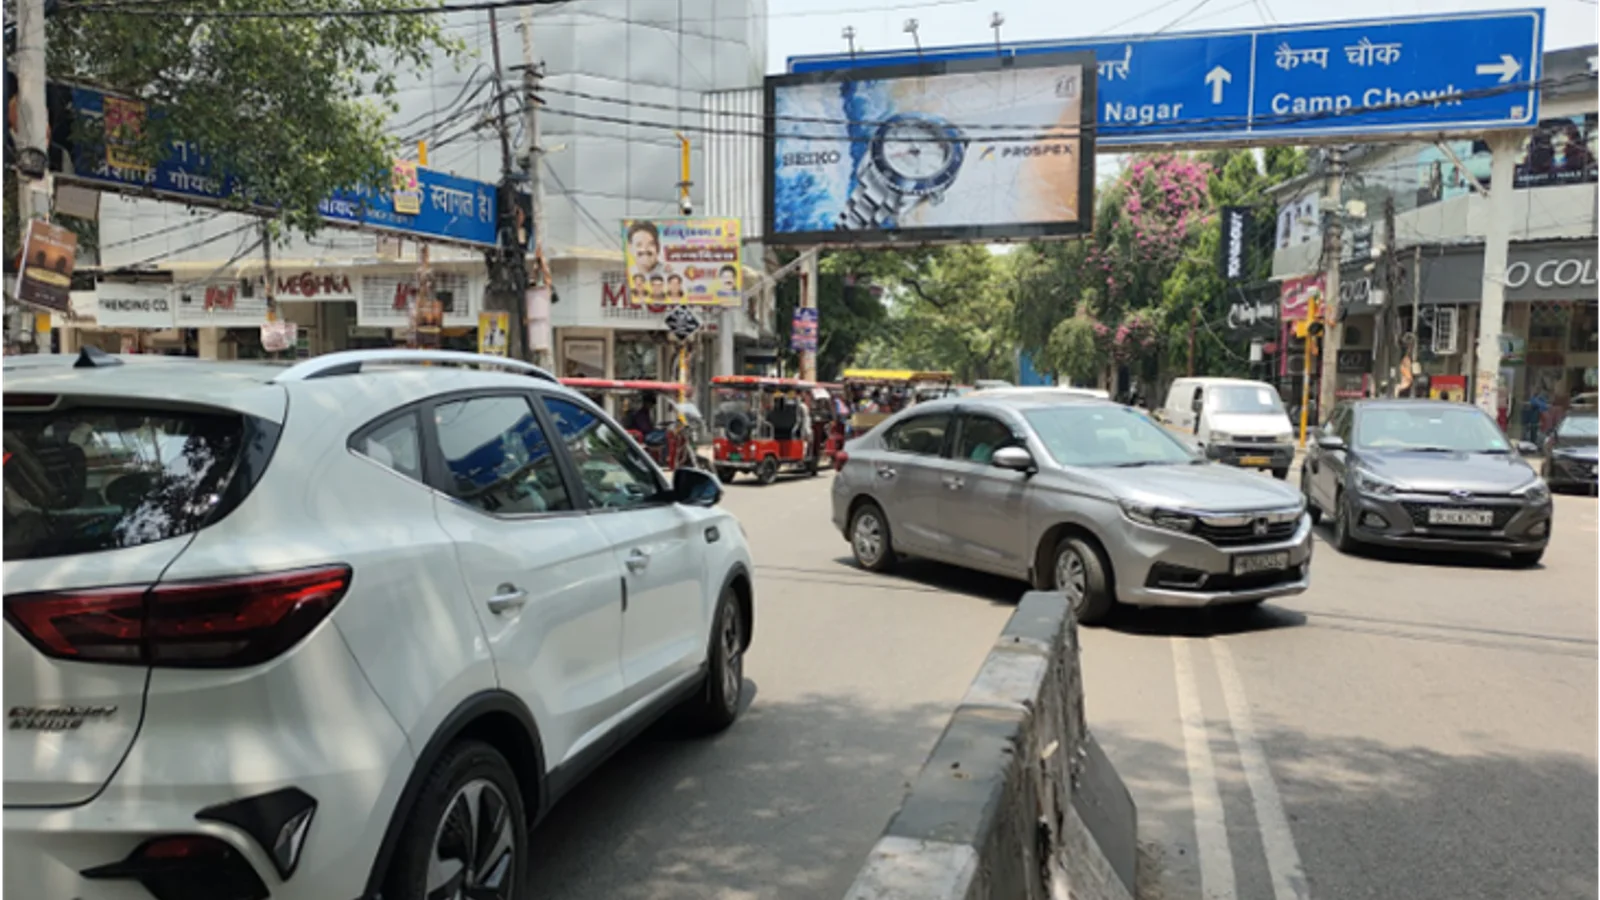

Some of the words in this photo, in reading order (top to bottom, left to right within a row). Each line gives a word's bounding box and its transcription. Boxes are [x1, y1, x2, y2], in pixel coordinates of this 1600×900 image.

[1274, 42, 1330, 70] कैम्प
[1344, 37, 1403, 66] चौक
[1105, 101, 1184, 125] Nagar
[1271, 93, 1351, 115] Camp
[1363, 84, 1463, 109] Chowk
[783, 150, 841, 166] SEIKO
[1002, 144, 1073, 158] PROSPEX
[430, 183, 474, 218] स्वागत
